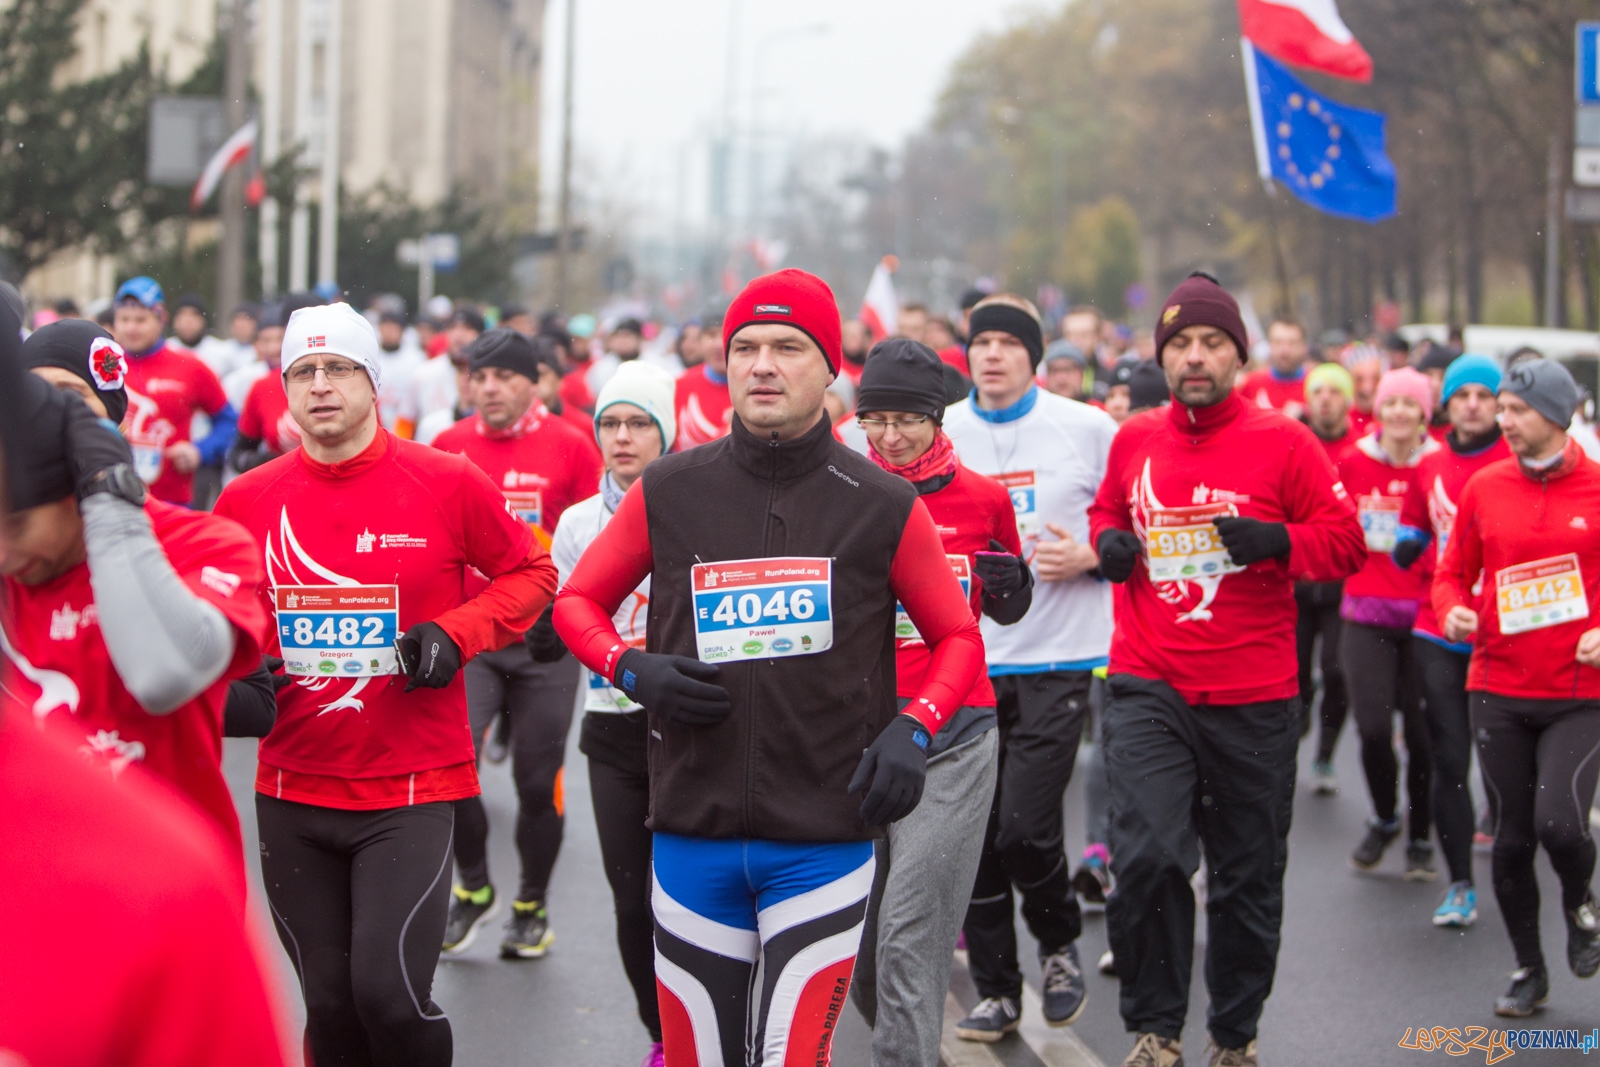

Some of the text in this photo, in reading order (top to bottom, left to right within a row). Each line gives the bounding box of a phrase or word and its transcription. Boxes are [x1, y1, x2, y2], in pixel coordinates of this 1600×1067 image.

[827, 464, 860, 488] Quechua
[379, 533, 388, 548] 1
[764, 567, 820, 578] RunPoland.org
[1508, 577, 1575, 610] 8442
[339, 596, 390, 605] RunPoland.org
[698, 588, 816, 627] E 4046
[281, 616, 385, 646] E 8482
[749, 628, 776, 637] Paweł
[319, 650, 354, 659] Grzegorz
[704, 646, 724, 654] GRUPA
[705, 651, 728, 660] LUXMED
